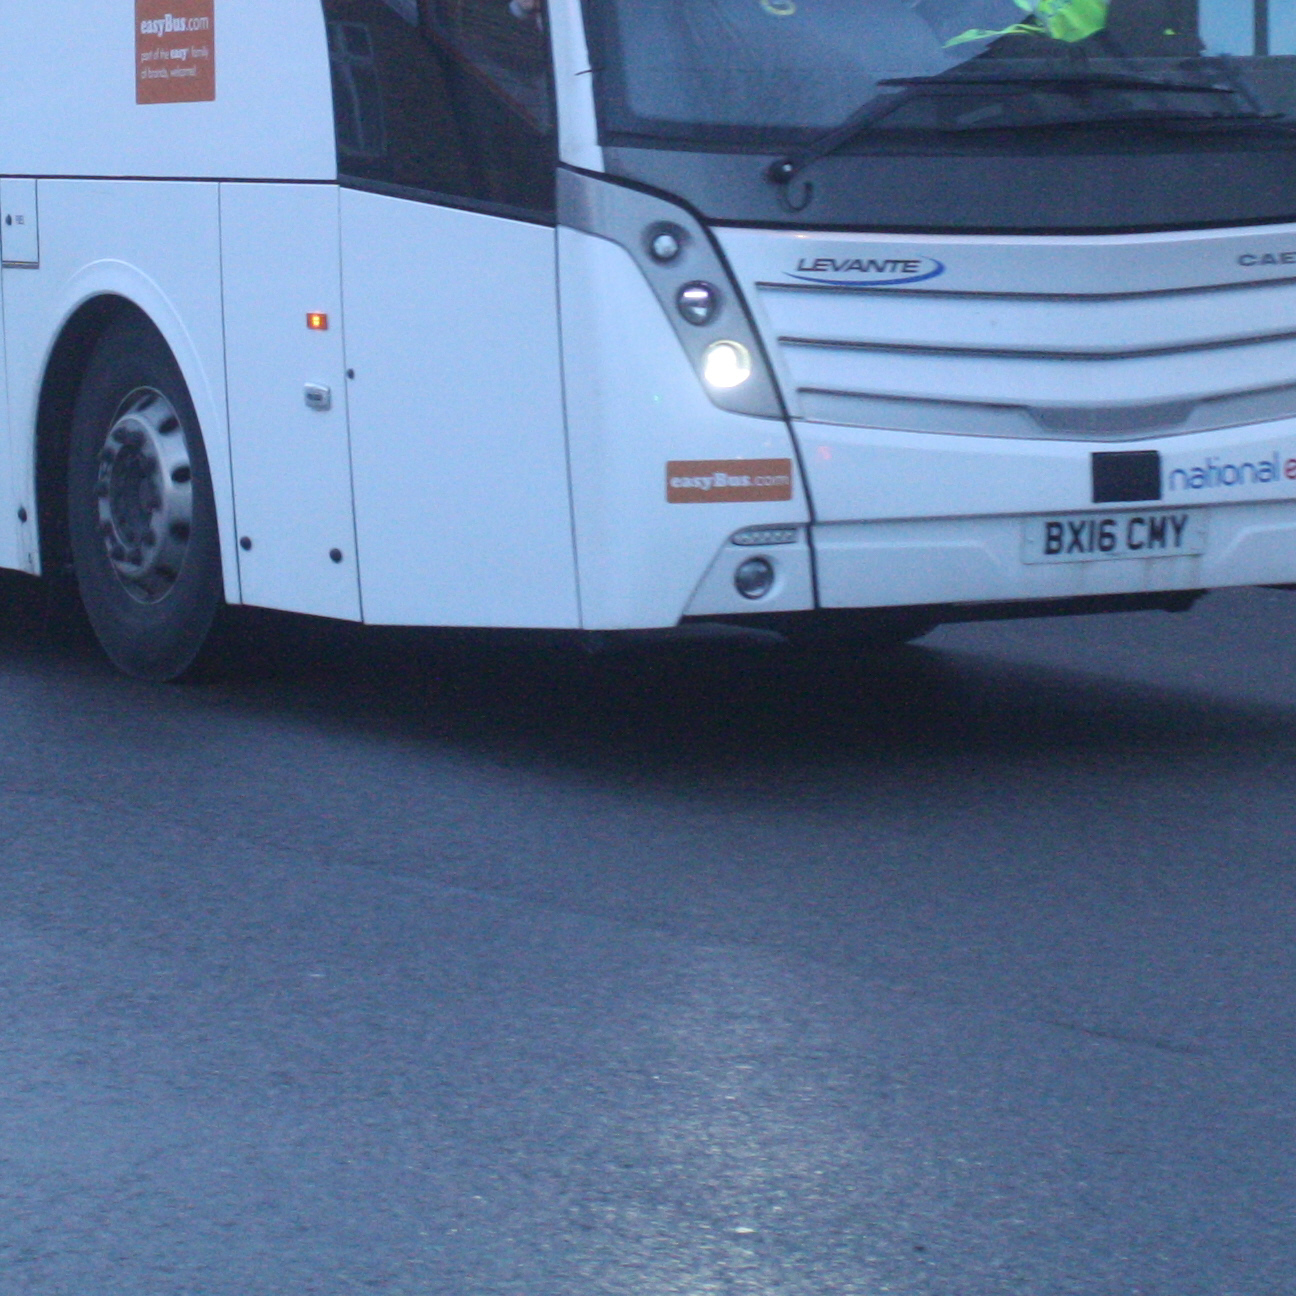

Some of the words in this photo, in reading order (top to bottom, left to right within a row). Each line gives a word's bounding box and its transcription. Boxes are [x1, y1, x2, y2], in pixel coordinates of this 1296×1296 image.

[140, 13, 210, 38] easyBus.com
[797, 258, 921, 273] LEVANTE
[669, 472, 790, 491] easyBus.com
[1168, 452, 1281, 491] national
[1044, 519, 1117, 554] BX16
[1125, 515, 1189, 551] CMY
